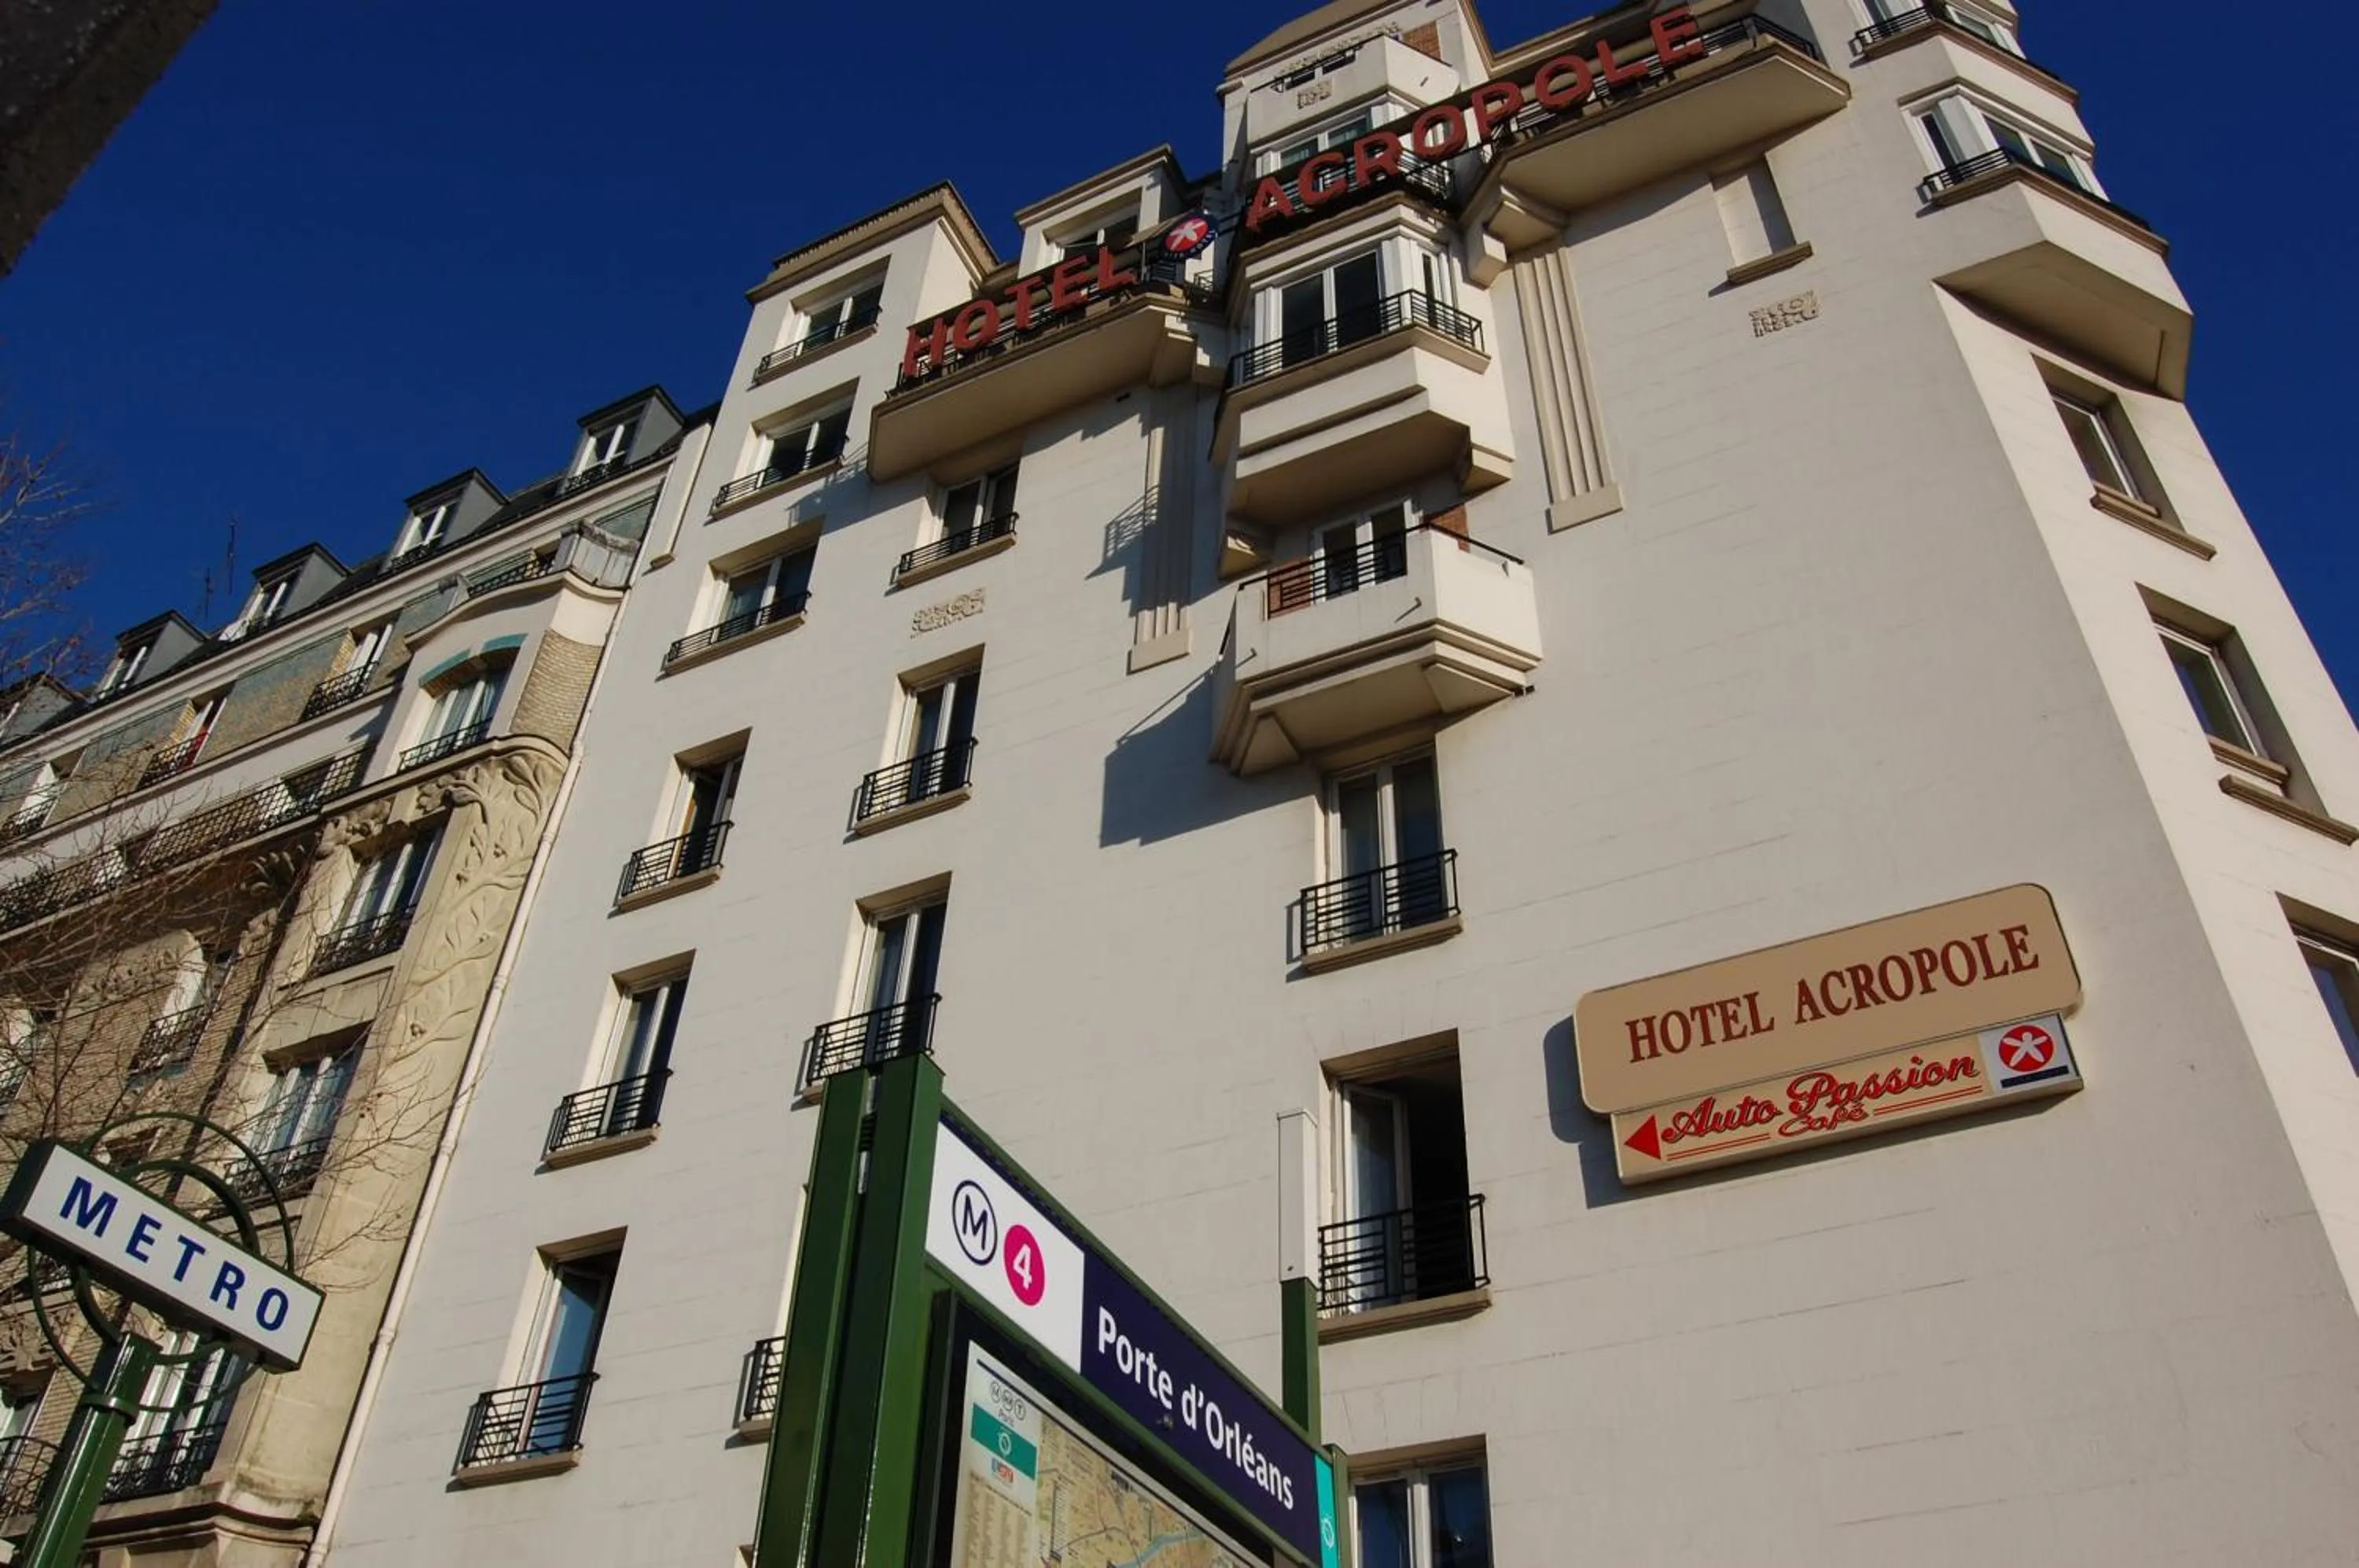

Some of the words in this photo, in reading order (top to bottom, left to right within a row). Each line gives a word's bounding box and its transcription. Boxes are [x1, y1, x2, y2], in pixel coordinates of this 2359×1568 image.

[903, 245, 1137, 378] HOTEL
[1246, 8, 1709, 230] ACROPOLE
[1625, 992, 1776, 1064] HOTEL
[1794, 924, 2039, 1025] ACROPOLE
[1660, 1095, 1783, 1143] Auto
[1786, 1055, 1981, 1116] Passion
[1778, 1102, 1869, 1137] Café
[59, 1176, 289, 1332] METRO
[1012, 1242, 1032, 1290] 4
[1098, 1305, 1174, 1411] Porte
[1180, 1383, 1294, 1511] d'Orléans
